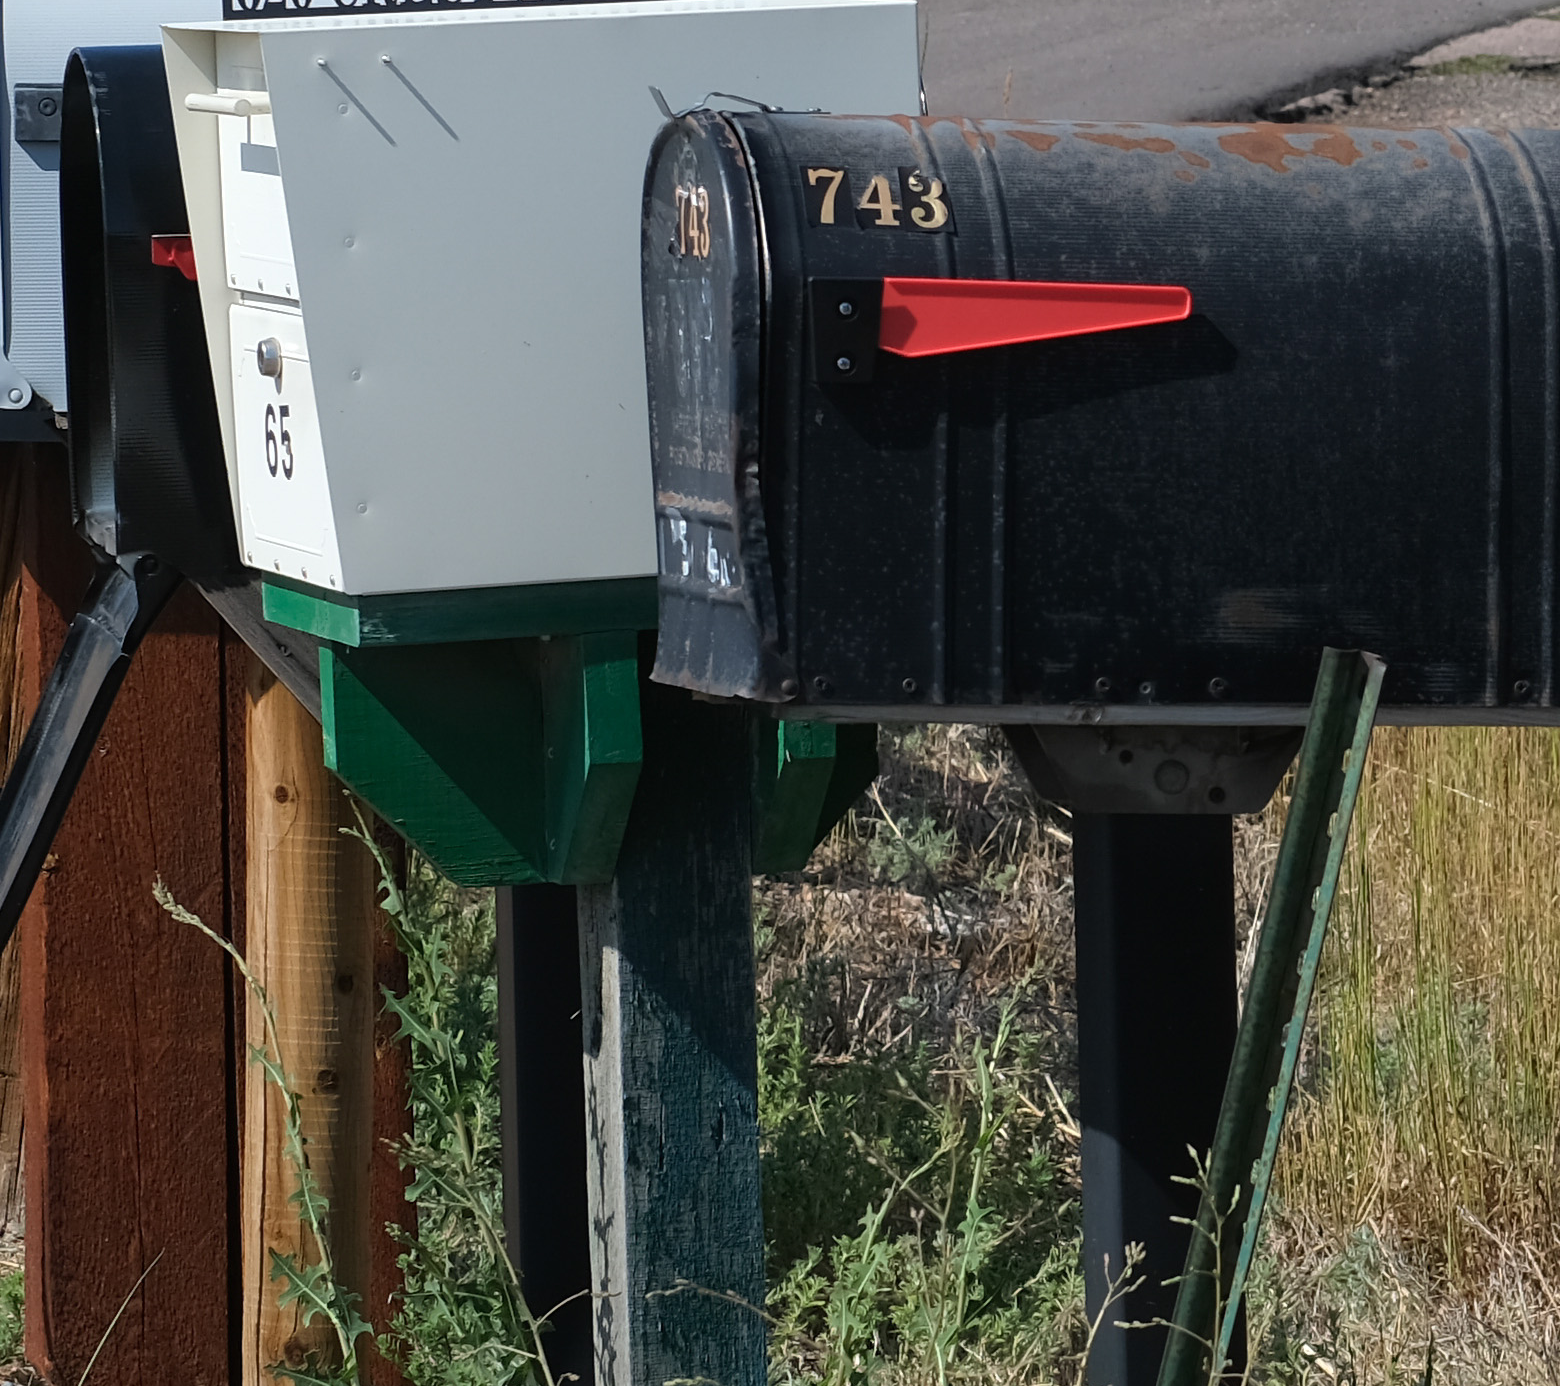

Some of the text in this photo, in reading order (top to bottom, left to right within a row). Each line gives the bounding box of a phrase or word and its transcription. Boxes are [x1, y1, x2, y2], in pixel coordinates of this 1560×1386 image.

[675, 185, 711, 259] 743
[807, 167, 949, 229] 743
[264, 403, 294, 480] 65
